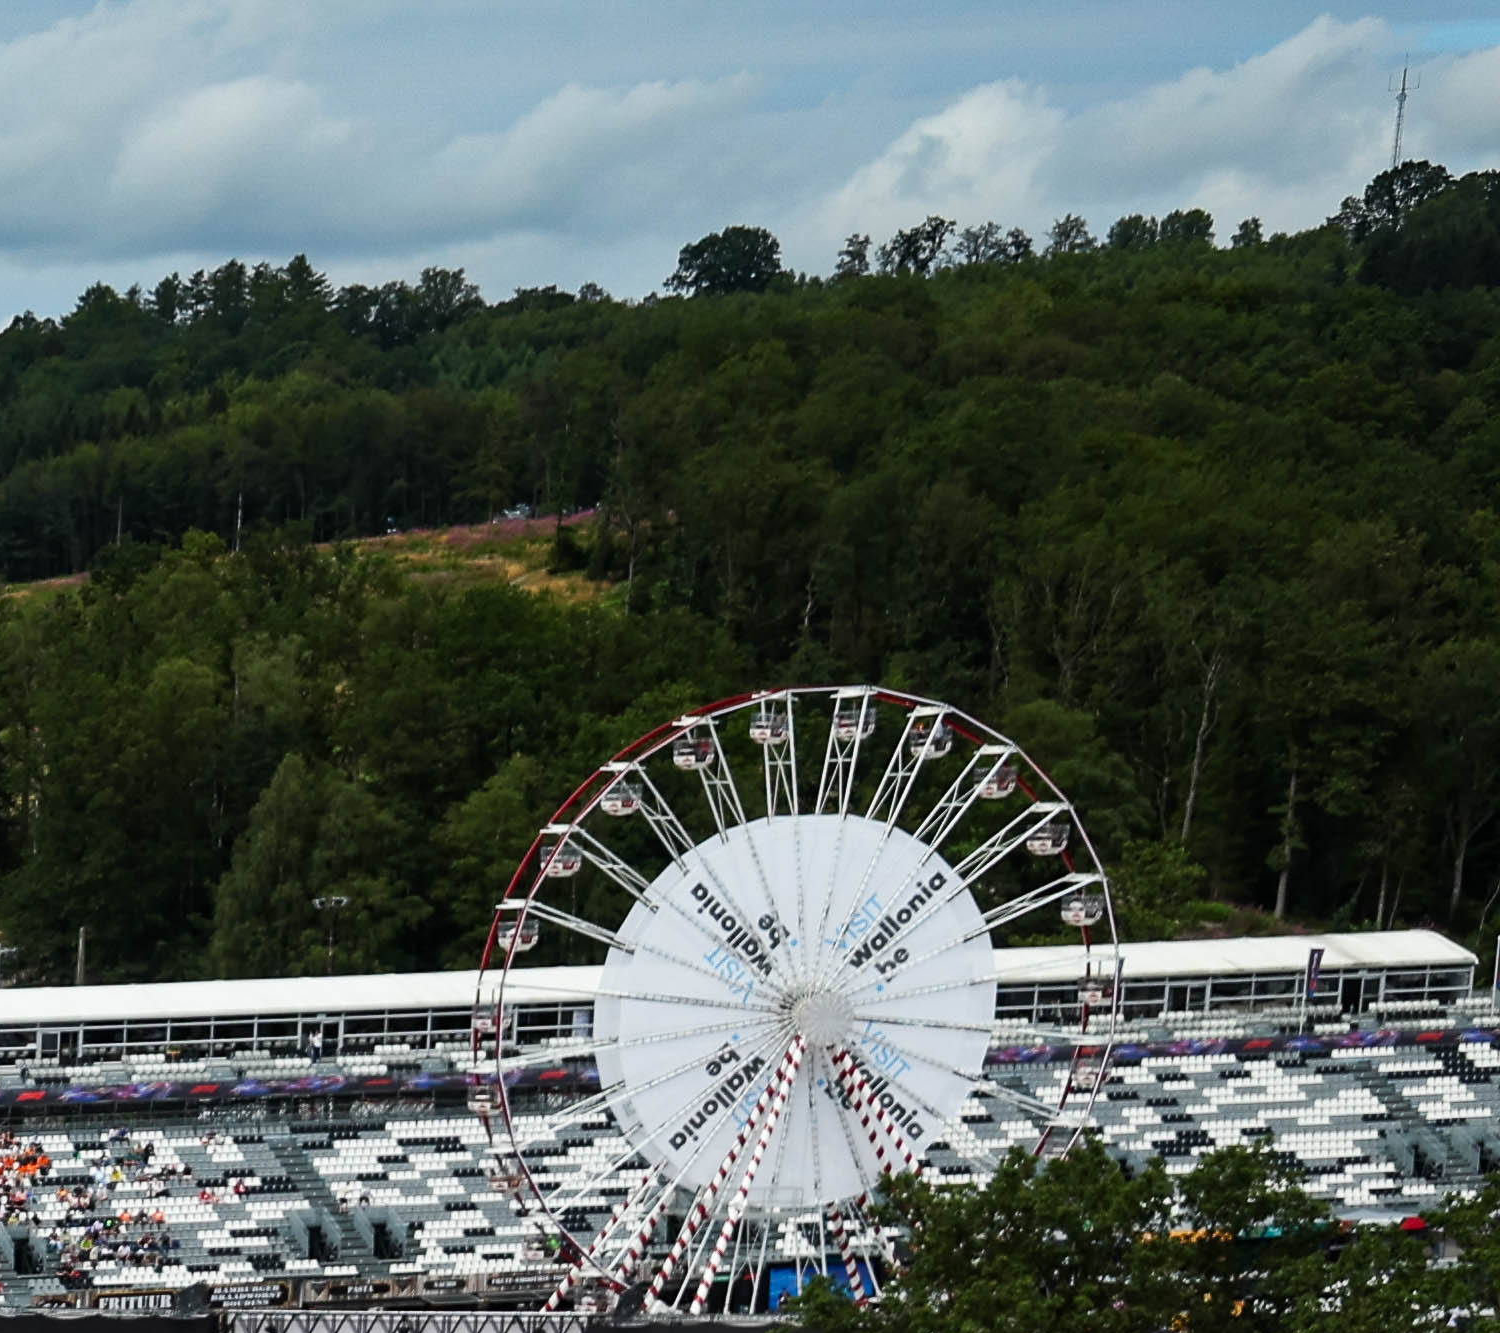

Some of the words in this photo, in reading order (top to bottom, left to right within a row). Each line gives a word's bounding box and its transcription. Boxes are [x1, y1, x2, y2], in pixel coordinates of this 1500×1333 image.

[690, 882, 773, 977] wallonia
[849, 872, 947, 968] wallonia
[668, 1056, 766, 1150] wallonia
